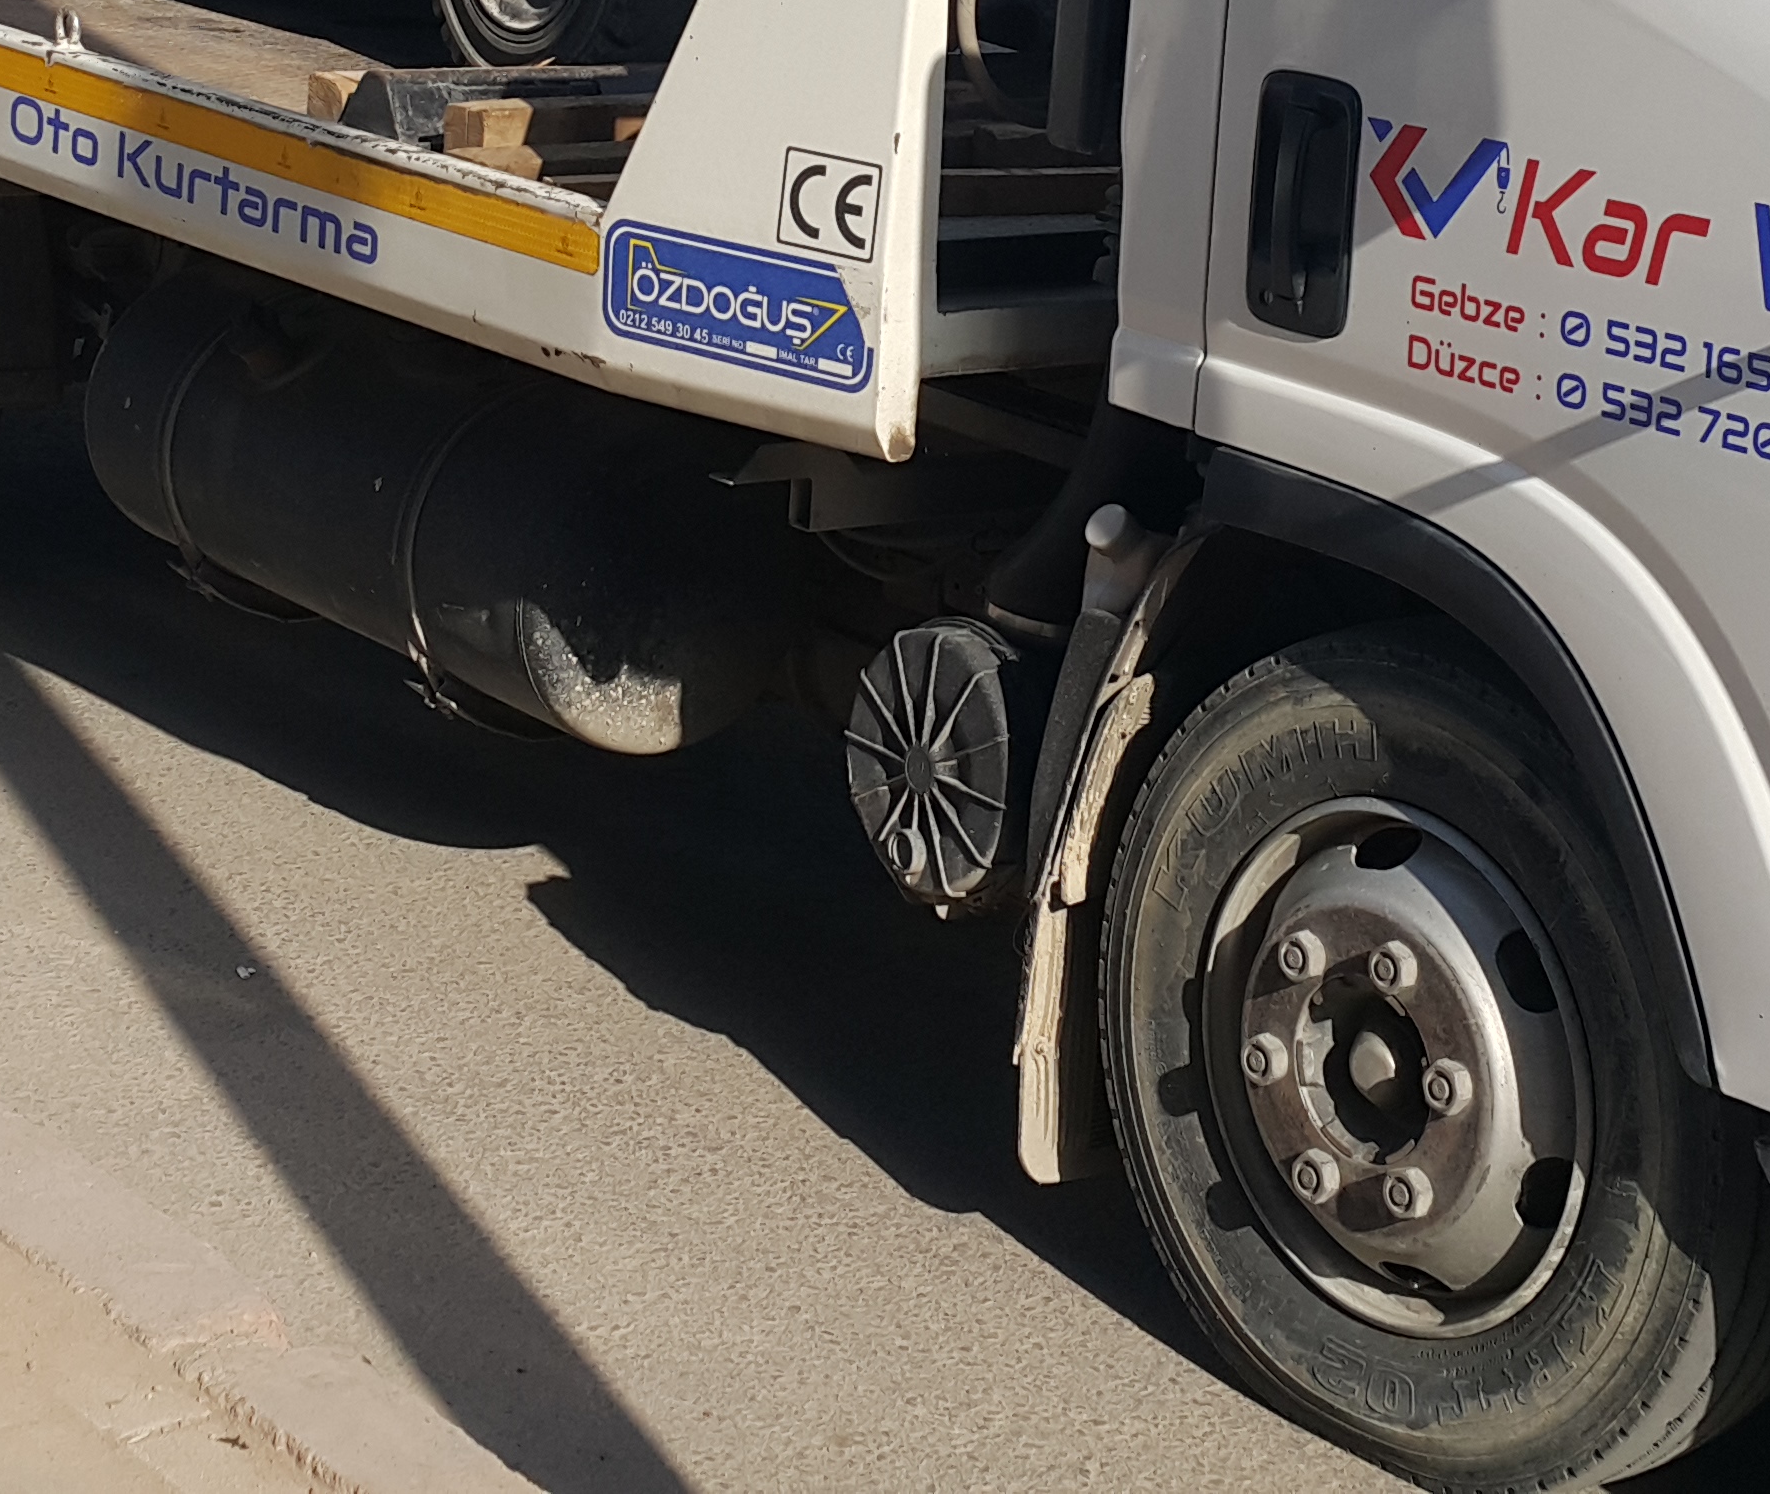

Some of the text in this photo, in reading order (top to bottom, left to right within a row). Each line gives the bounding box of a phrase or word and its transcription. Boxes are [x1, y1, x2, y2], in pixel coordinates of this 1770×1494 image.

[10, 95, 99, 167] Oto
[117, 130, 379, 265] Kurtarma
[789, 164, 873, 250] CE
[1506, 158, 1711, 286] Kar
[619, 309, 648, 329] 0212
[651, 317, 673, 335] 549
[676, 323, 691, 339] 30
[693, 328, 709, 344] 45
[632, 262, 813, 345] ÖZDOĞUŞ
[1410, 274, 1525, 333] Gebze
[1560, 310, 1591, 348] 0
[1604, 318, 1687, 372] 532
[1407, 334, 1521, 394] Düzce
[1557, 372, 1587, 410] 0
[1601, 382, 1682, 437] 532
